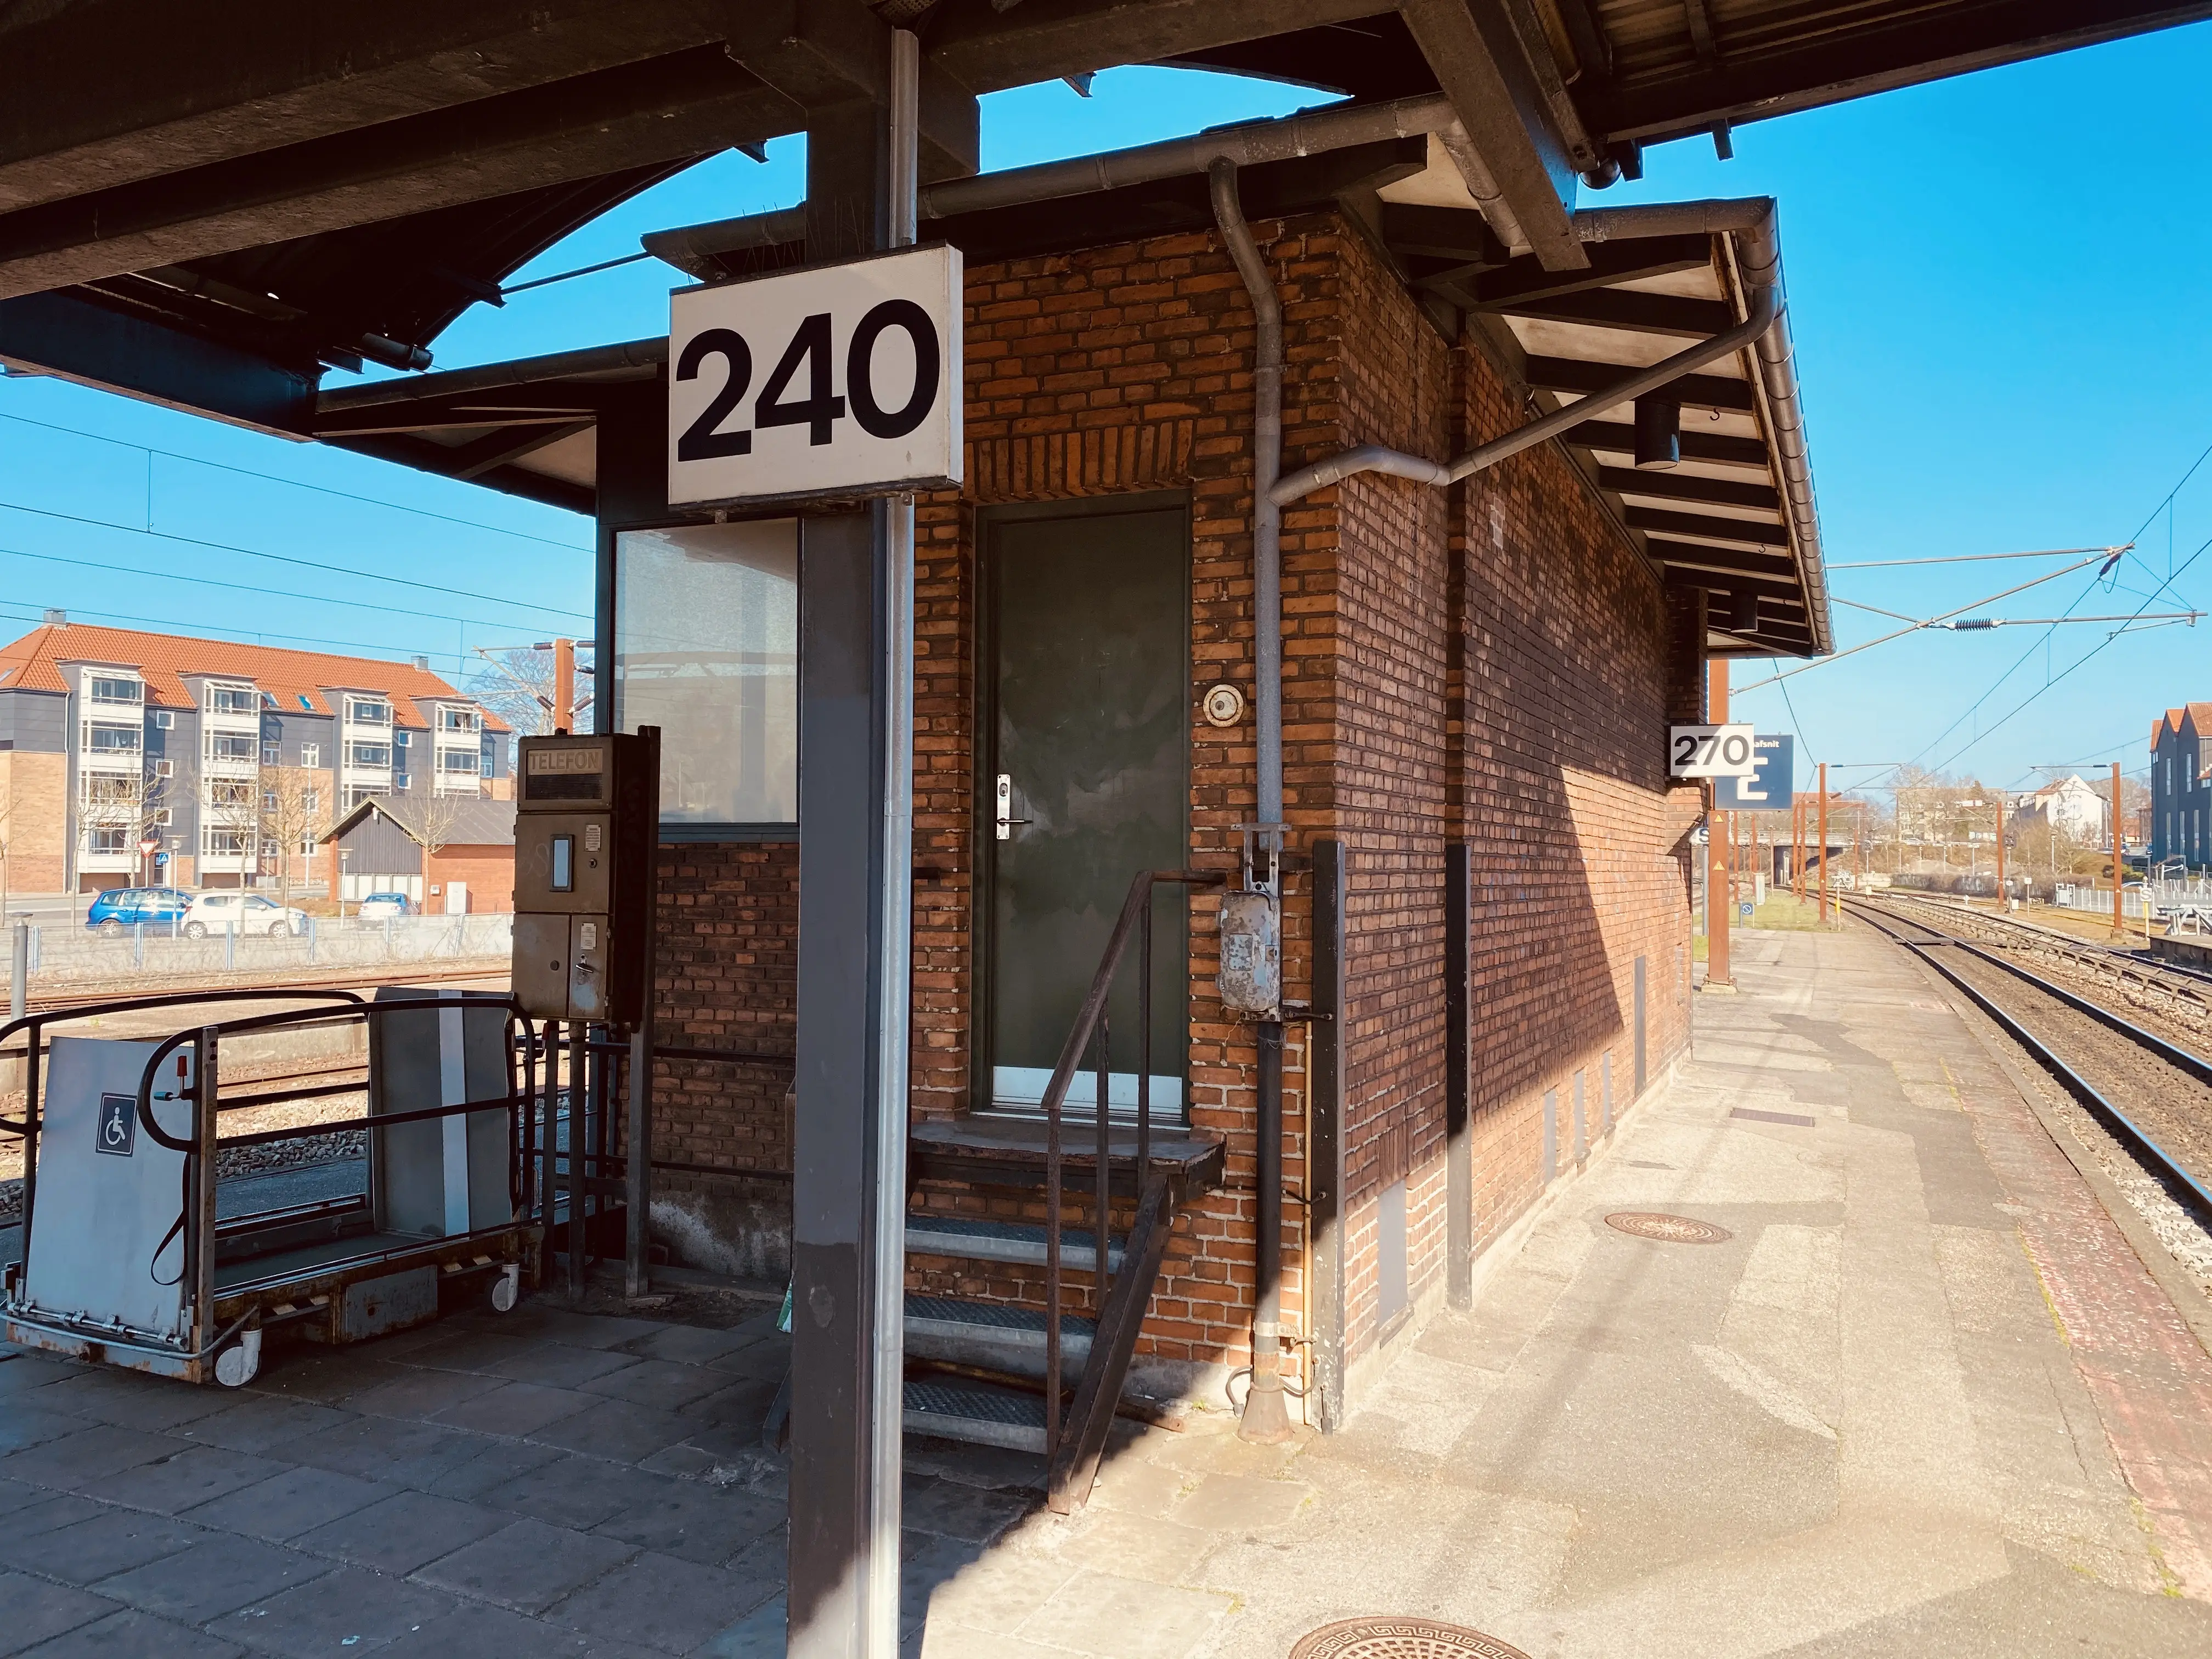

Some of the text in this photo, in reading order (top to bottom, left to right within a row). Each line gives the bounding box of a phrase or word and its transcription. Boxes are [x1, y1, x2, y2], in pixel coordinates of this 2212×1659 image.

[676, 300, 940, 461] 240
[529, 752, 599, 769] TELEFON
[1675, 735, 1749, 765] 270
[1737, 757, 1768, 800] E
[2140, 889, 2151, 900] S
